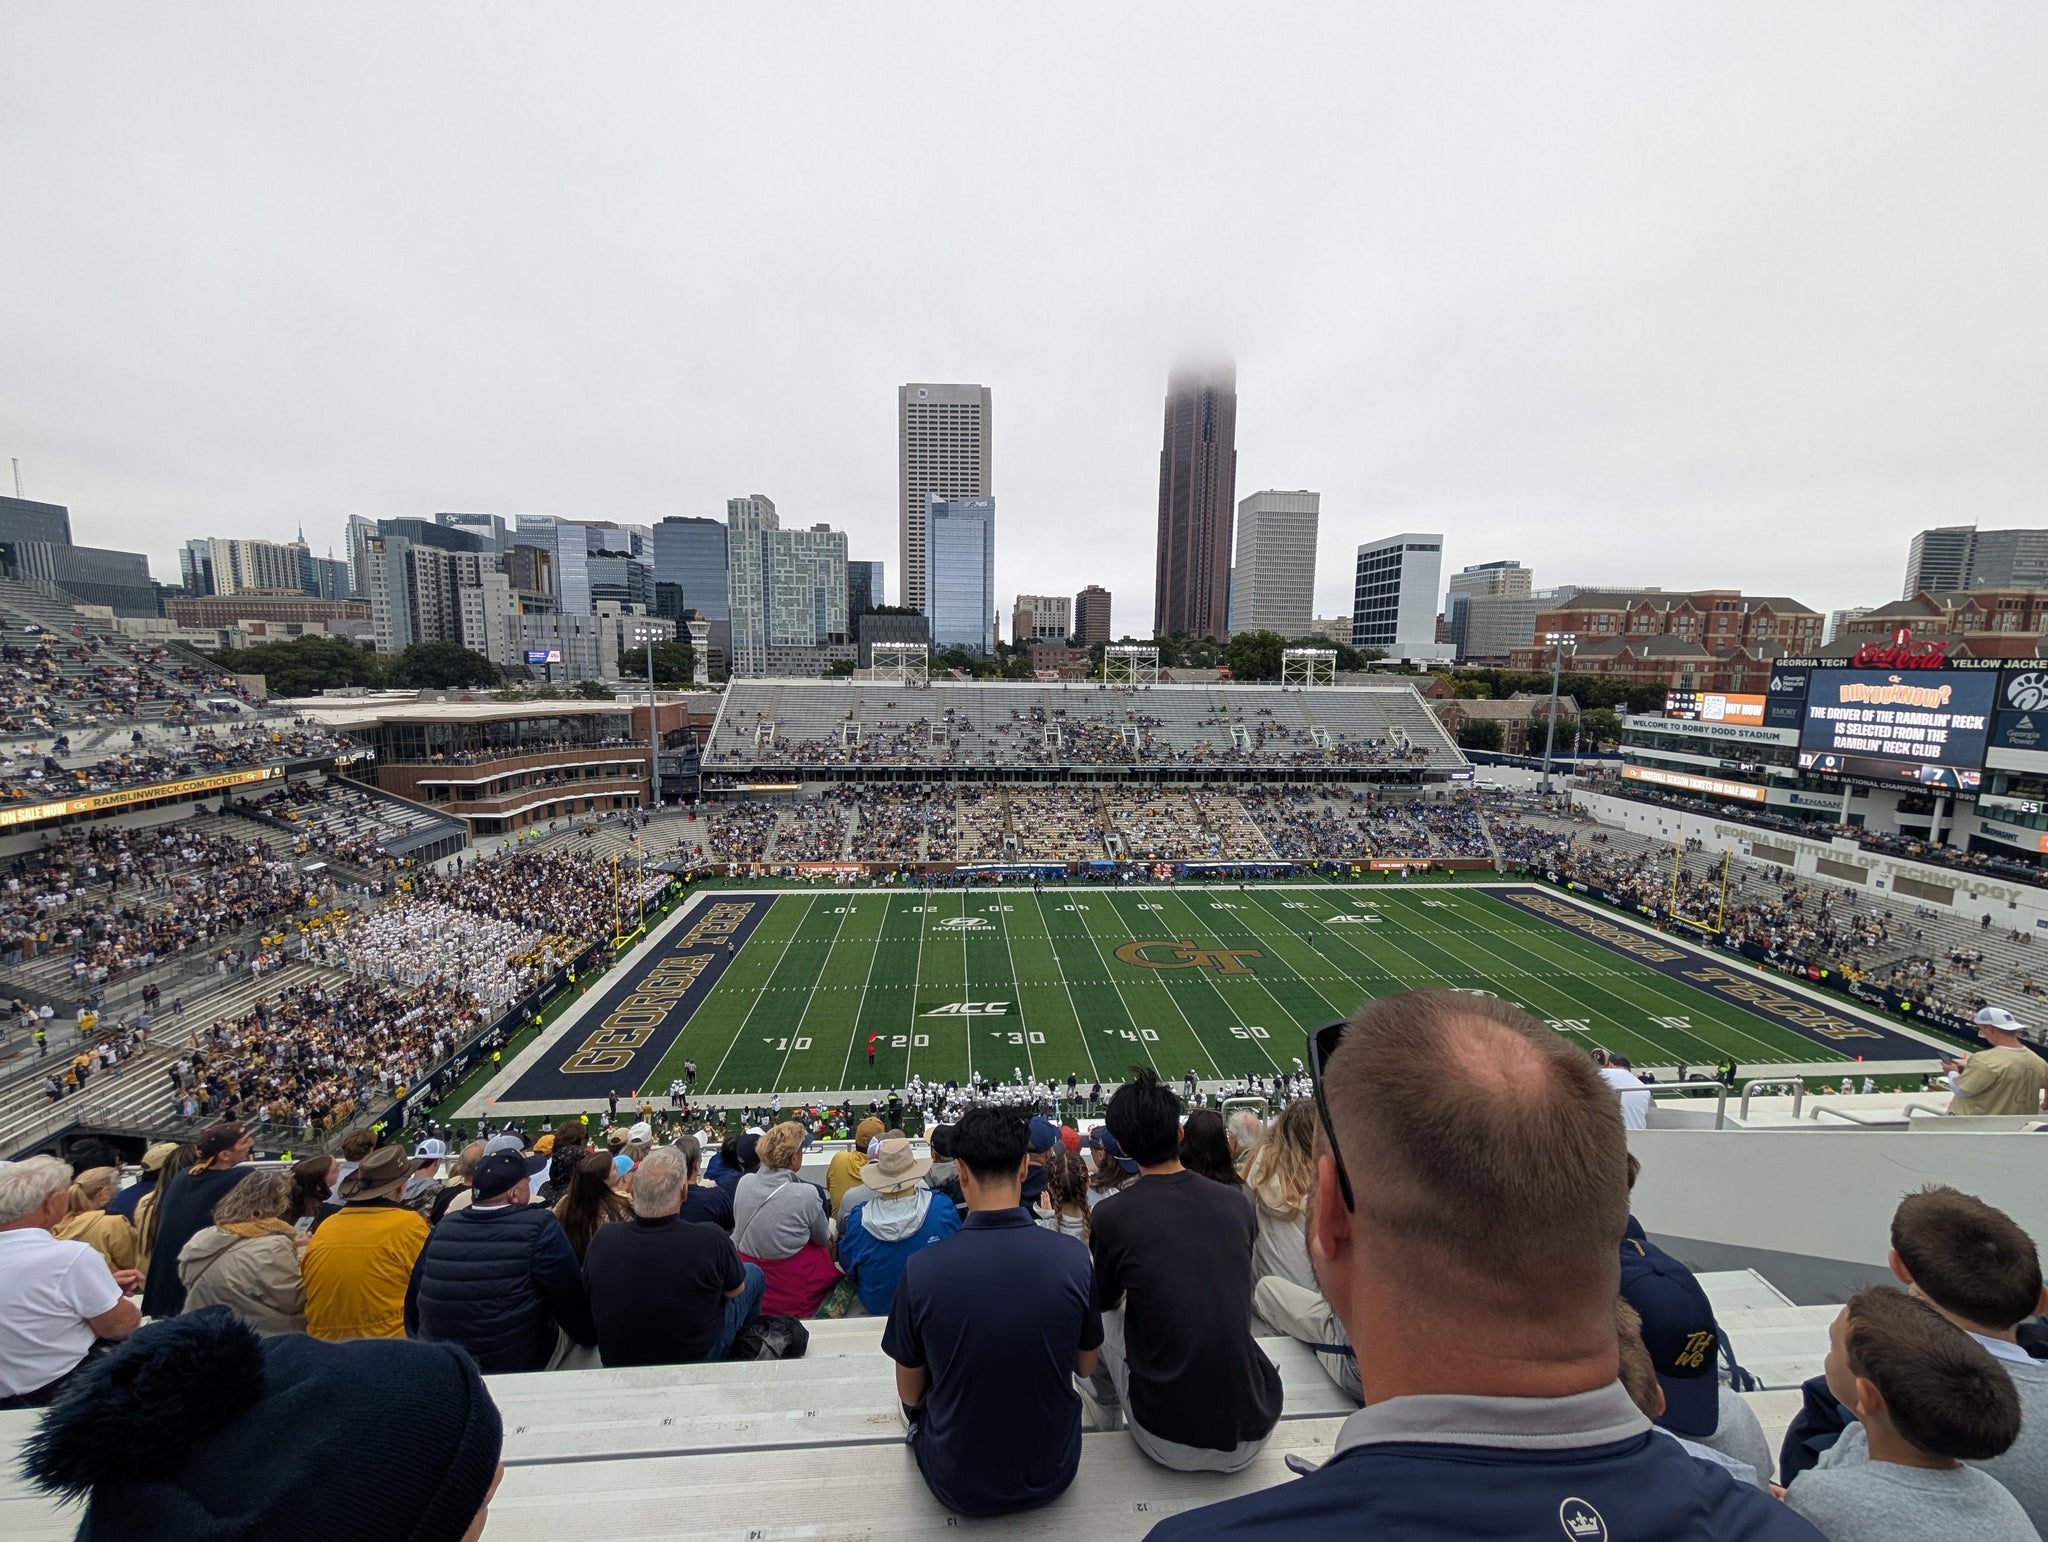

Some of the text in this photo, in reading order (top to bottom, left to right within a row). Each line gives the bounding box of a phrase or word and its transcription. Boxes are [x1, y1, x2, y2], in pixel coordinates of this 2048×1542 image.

[1776, 658, 1848, 667] GEORGIA TECH
[1951, 658, 2001, 669] YELLOW
[1725, 703, 1763, 716] BUY NOW
[1772, 707, 1798, 716] EMORY
[1809, 706, 1985, 730] THE DRIVER OF THE RAMBLIN' RECK
[1632, 719, 1780, 741] WELCOME TO BOBBY DODD STADIUM
[1834, 722, 1948, 743] IS SELECTED FROM THE
[2006, 729, 2041, 739] Georgia
[1833, 737, 1942, 758] RAMBLIN' RECK CLUB
[2009, 737, 2037, 746] Power
[1825, 756, 1836, 767] 0
[1933, 768, 1945, 780] 7
[1641, 770, 1666, 783] BASEBALL
[1666, 774, 1689, 786] SEASON
[1689, 778, 1713, 791] TICKETS
[1723, 784, 1740, 796] SALE
[1740, 787, 1758, 799] NOW
[1806, 772, 1977, 801] 1917 1928 NATIONAL CHAMPIONS 1952 1990
[1, 813, 16, 825] ON
[17, 807, 42, 822] SALE
[43, 802, 67, 817] NOW
[93, 775, 243, 807] RAMBLINWRECK.COM/TICKETS
[2020, 801, 2039, 814] 25
[1714, 824, 2023, 901] GEORGIA INSTITUTE OF TECHNOLOGY
[1325, 914, 1383, 923] ACC
[559, 902, 756, 1074] GEORGIA TECH
[925, 1001, 1012, 1014] ACC
[1681, 967, 1886, 1041] TECH
[1544, 1018, 1591, 1031] 20
[1647, 1016, 1693, 1028] 10
[1927, 1011, 1960, 1029] DELTA
[1007, 1031, 1046, 1045] 30
[1119, 1028, 1160, 1042] 40
[1229, 1026, 1271, 1039] 50
[776, 1037, 813, 1050] 10
[891, 1034, 930, 1048] 20
[1686, 1330, 1714, 1353] TH
[1674, 1351, 1705, 1368] WG
[1136, 1503, 1148, 1512] 12
[947, 1516, 958, 1526] 13
[750, 1530, 761, 1540] 14
